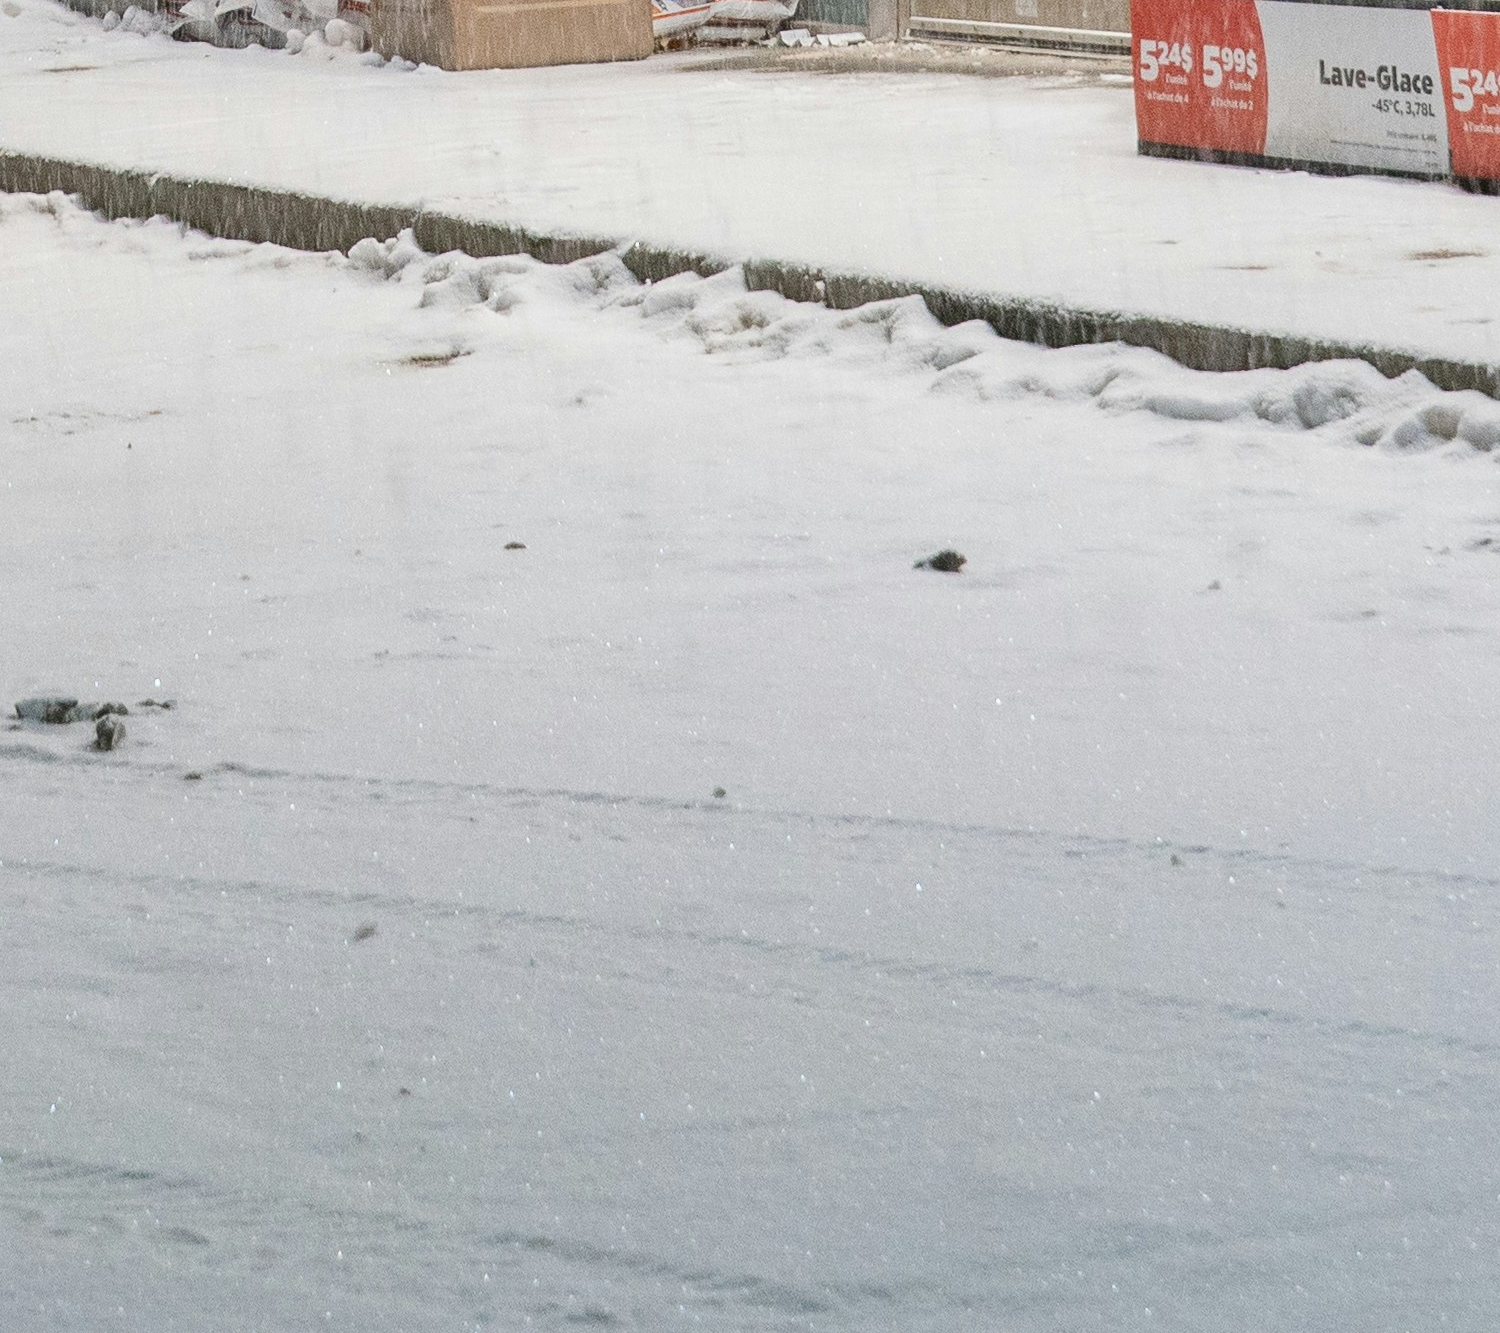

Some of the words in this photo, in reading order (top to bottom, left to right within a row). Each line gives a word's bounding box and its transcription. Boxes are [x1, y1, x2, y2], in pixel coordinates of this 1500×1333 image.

[1140, 39, 1192, 82] 524$
[1203, 44, 1258, 88] 599$
[1319, 59, 1434, 95] Lave-Glace
[1405, 100, 1436, 118] 3,78L
